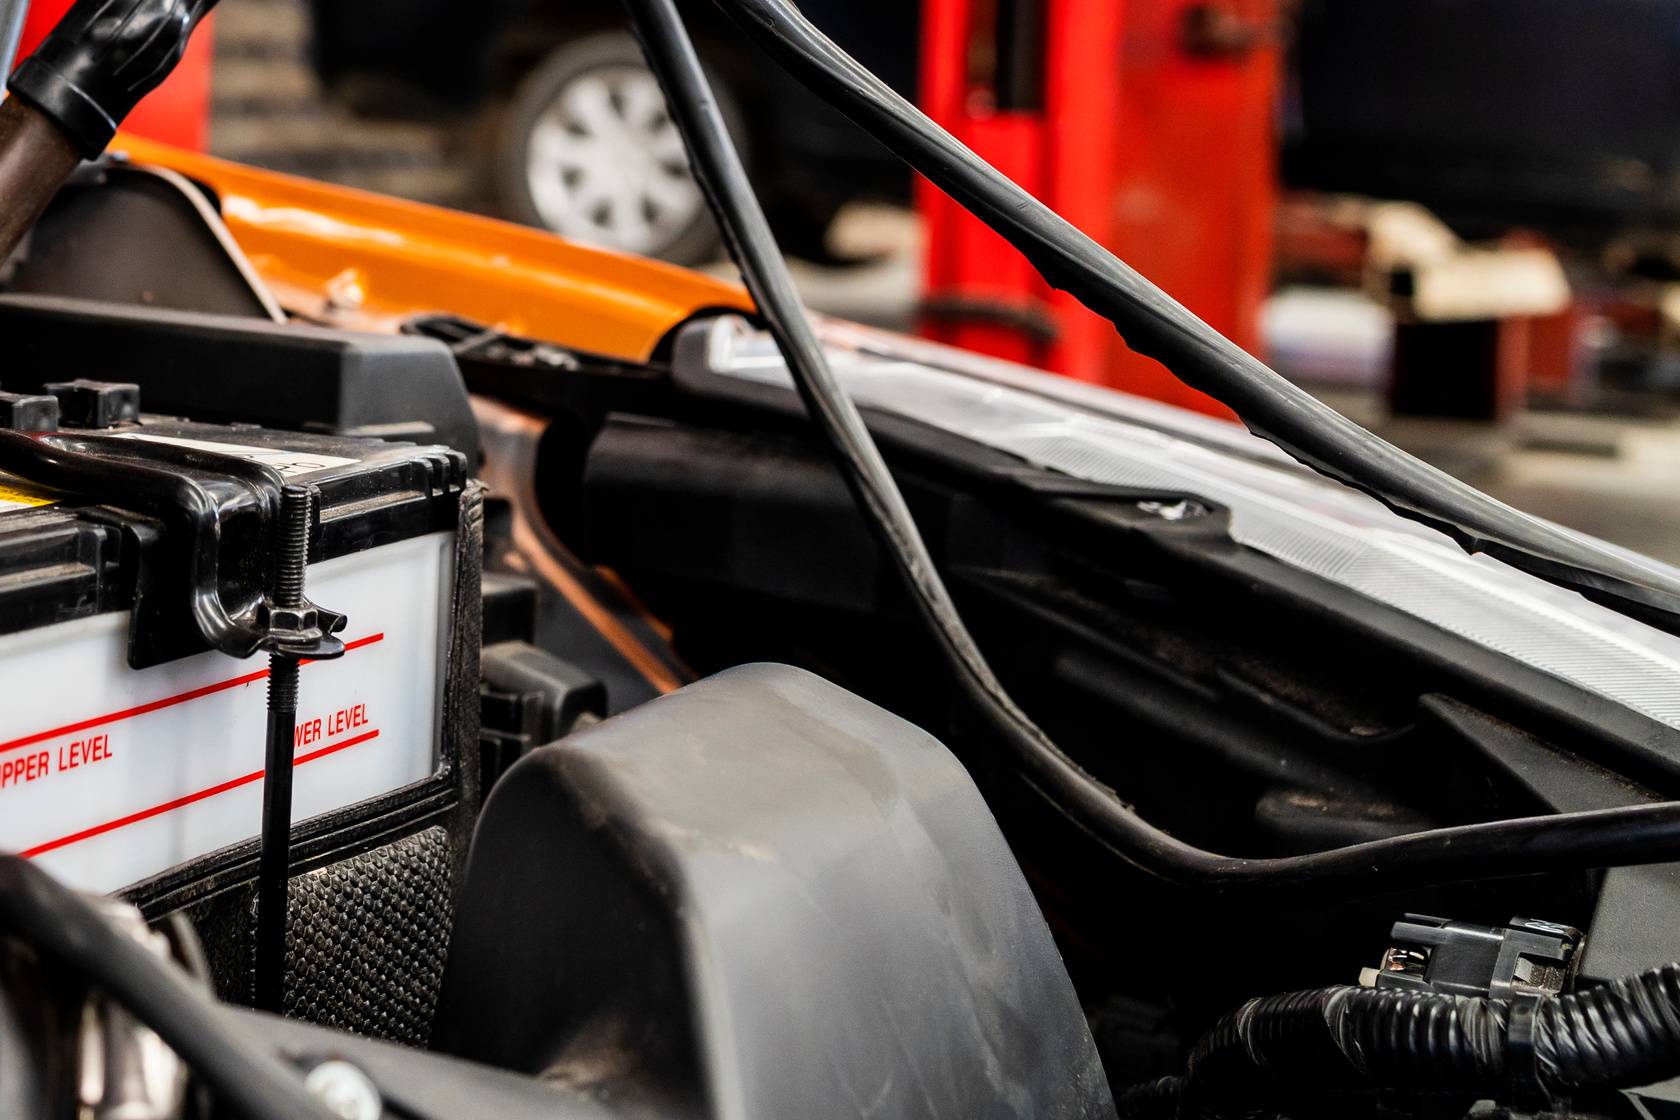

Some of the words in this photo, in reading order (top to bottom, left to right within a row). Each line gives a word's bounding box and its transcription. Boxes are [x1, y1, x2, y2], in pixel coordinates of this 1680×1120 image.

[294, 718, 322, 748] WER
[328, 703, 369, 737] LEVEL
[58, 734, 113, 772] LEVEL
